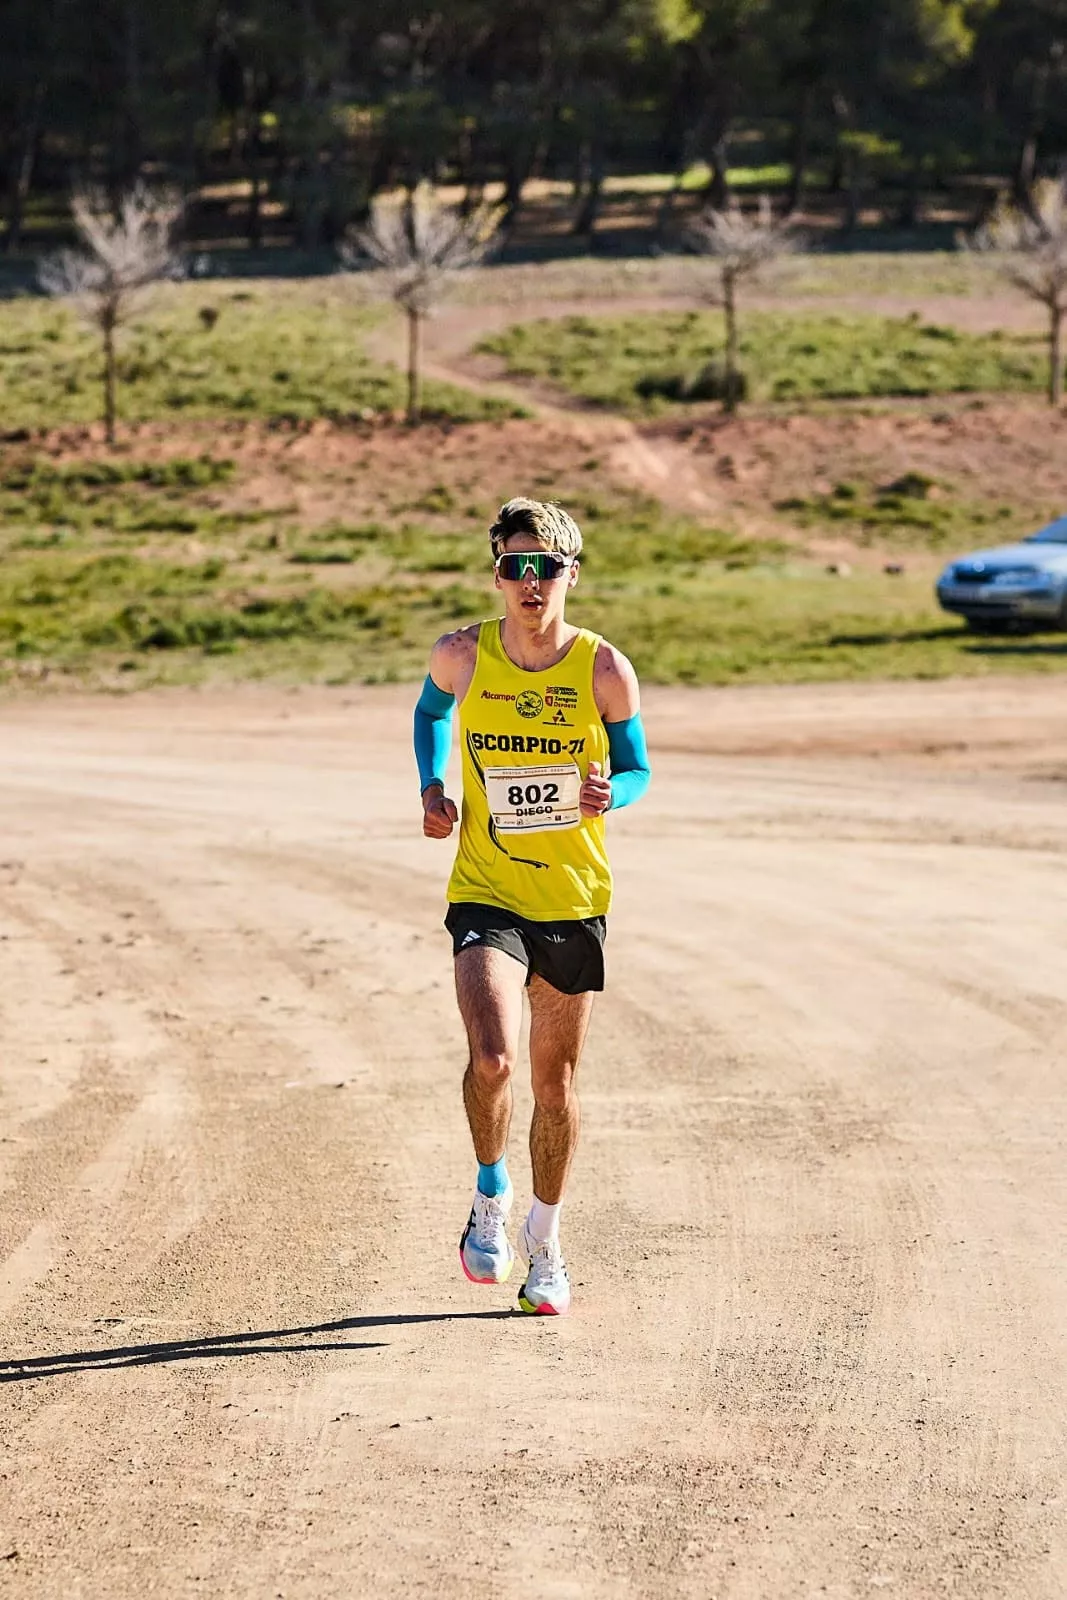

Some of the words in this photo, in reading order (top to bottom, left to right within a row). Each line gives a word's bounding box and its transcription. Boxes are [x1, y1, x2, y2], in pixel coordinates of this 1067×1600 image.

[481, 690, 516, 702] Alcampo
[471, 733, 586, 754] SCORPIO-71
[508, 783, 559, 805] 802
[516, 805, 553, 816] DIEGO
